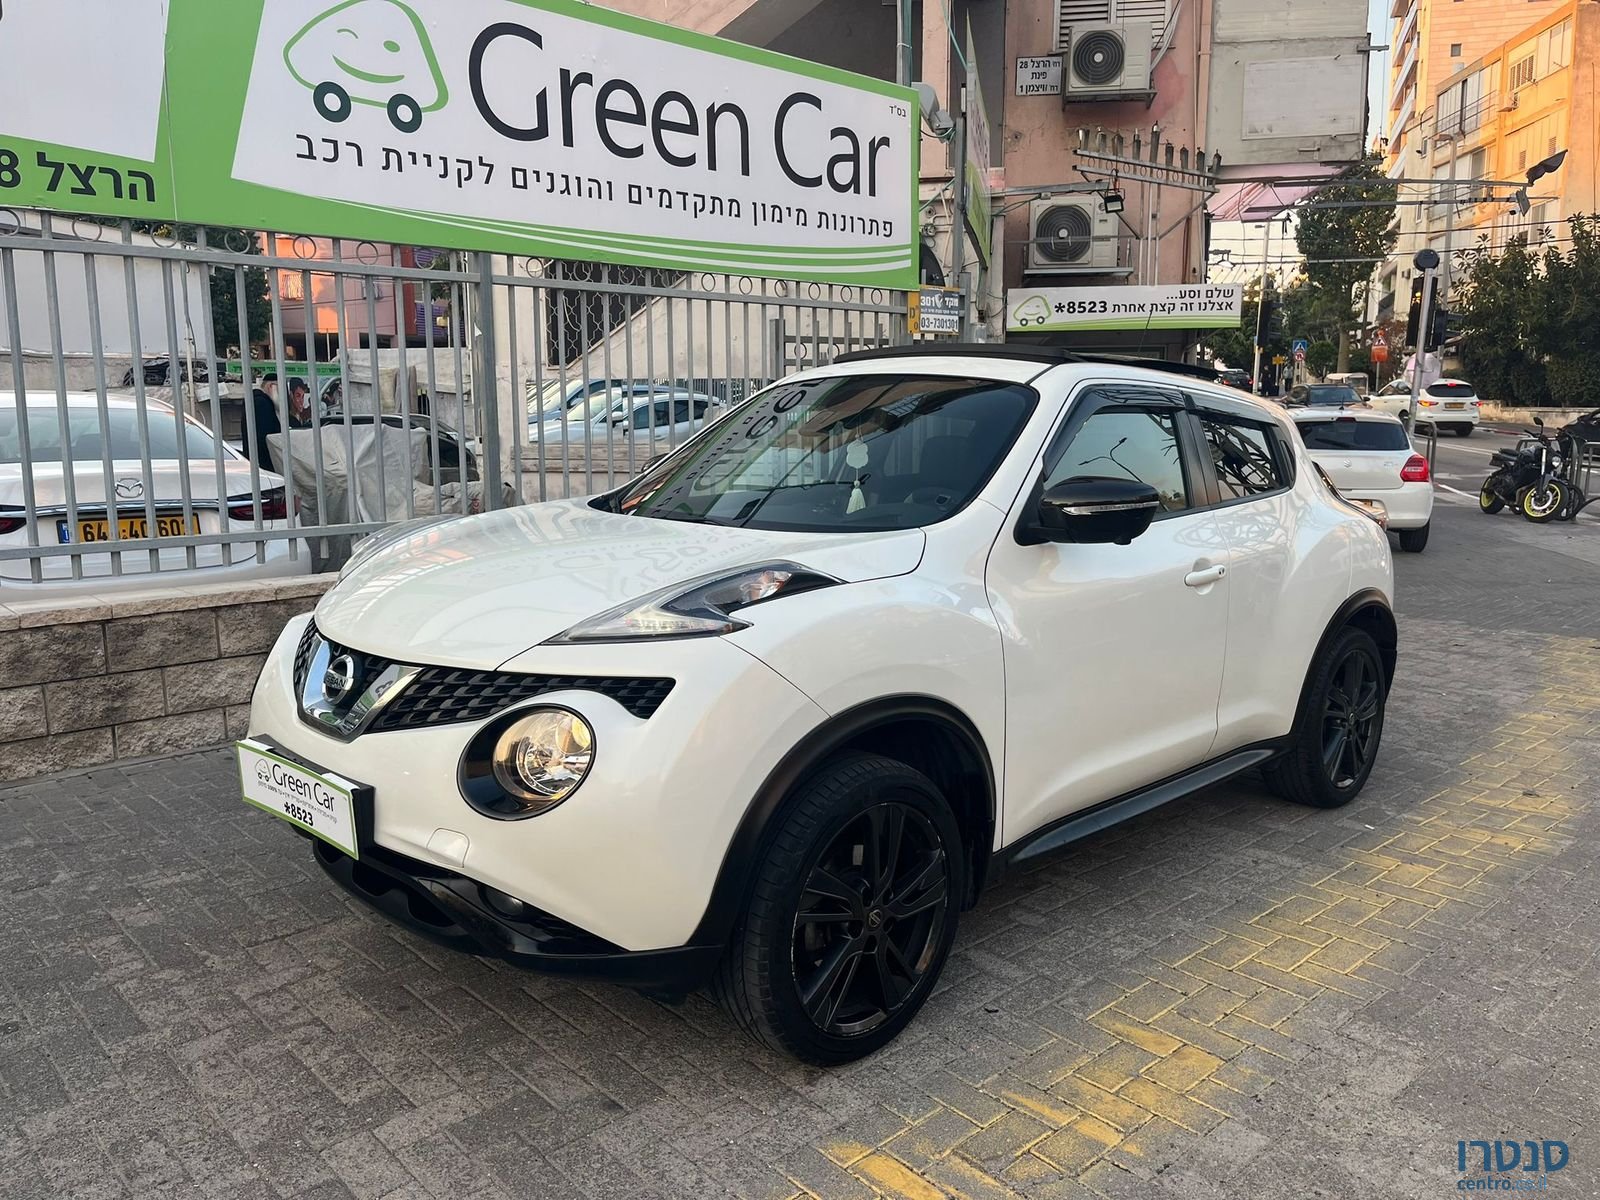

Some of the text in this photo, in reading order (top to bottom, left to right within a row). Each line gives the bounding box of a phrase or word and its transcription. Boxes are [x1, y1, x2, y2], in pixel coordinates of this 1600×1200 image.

[1019, 61, 1029, 69] 28
[1030, 58, 1051, 69] הרצל
[1030, 71, 1048, 80] פינת
[1019, 84, 1024, 93] 1
[468, 21, 750, 177] Green
[774, 91, 891, 198] Car
[36, 151, 156, 203] הרצל
[296, 133, 894, 239] פתרונות מימון מתקדמים והוגנים לקניית רכב
[1166, 286, 1235, 300] שלם וסע...
[920, 296, 935, 307] 301
[1111, 301, 1146, 313] אחרת
[1150, 301, 1176, 314] קצת
[1179, 301, 1194, 312] זה
[1197, 299, 1234, 312] אצלנו
[272, 763, 312, 801] Green
[313, 782, 336, 813] Car
